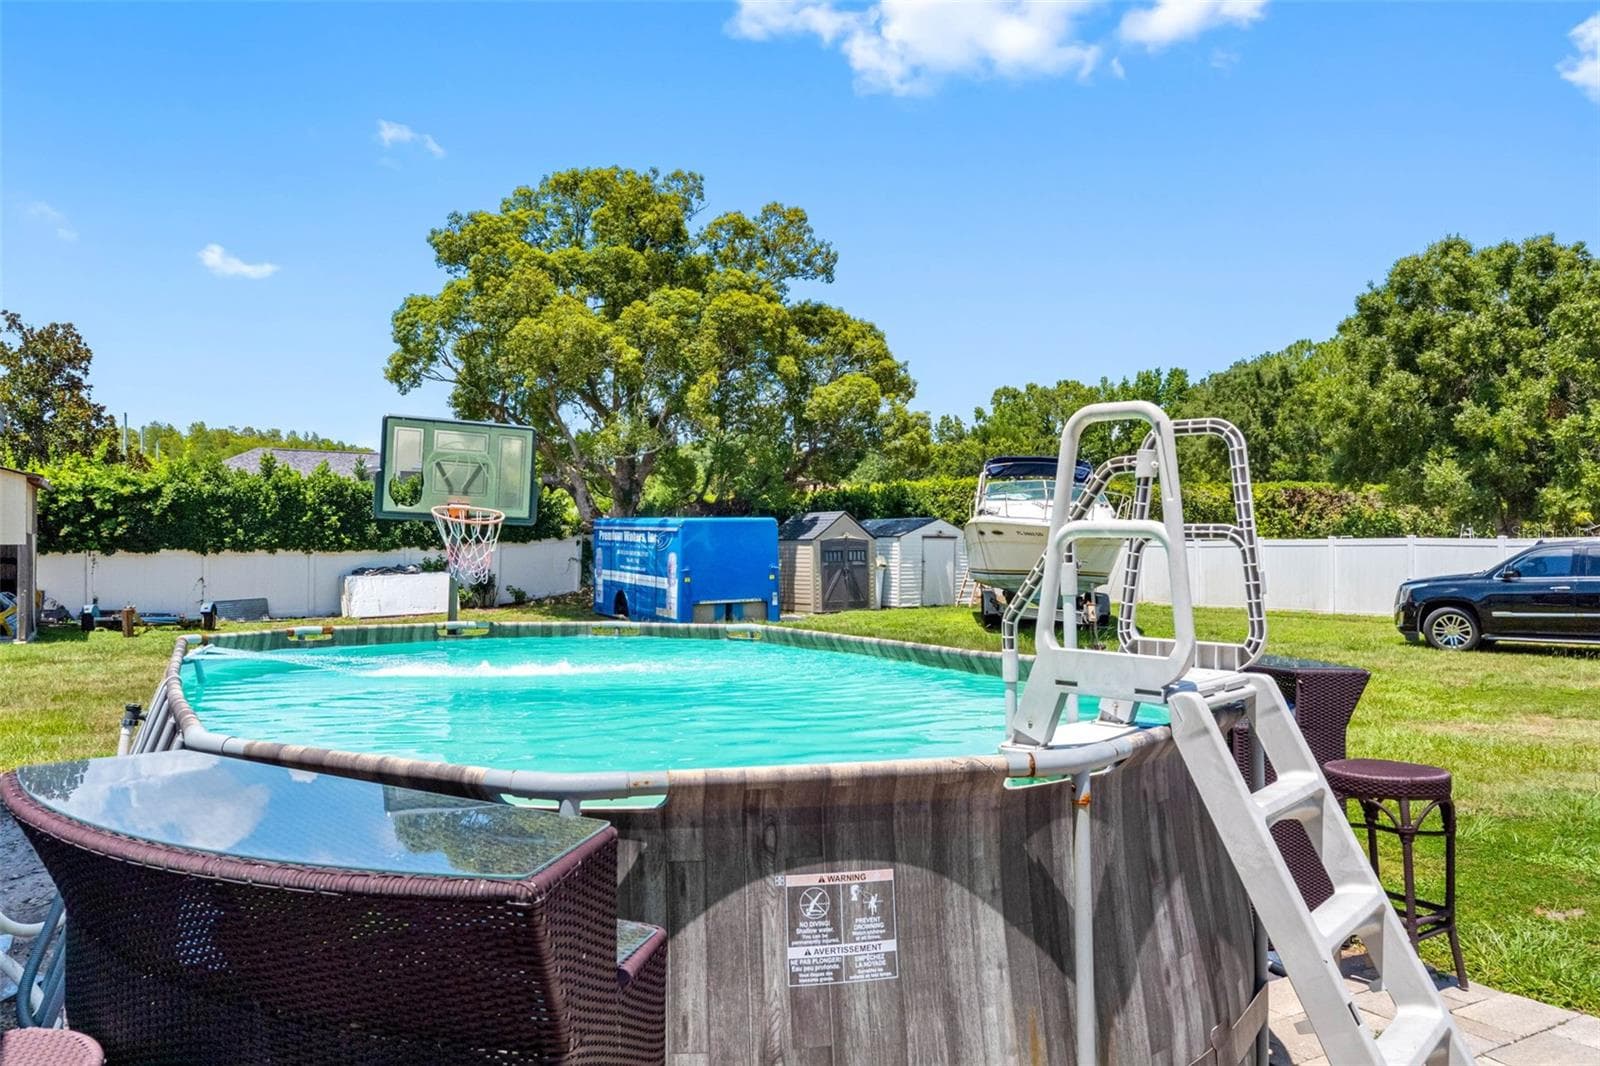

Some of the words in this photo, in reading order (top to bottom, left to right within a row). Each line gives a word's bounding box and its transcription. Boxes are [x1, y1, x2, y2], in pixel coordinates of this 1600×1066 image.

[598, 530, 623, 541] Premium
[624, 531, 647, 544] Waters,
[827, 873, 867, 883] WARNING
[810, 920, 830, 928] DIVING!
[855, 916, 881, 924] PREVENT
[853, 922, 885, 931] DROWNING
[813, 943, 882, 955] AVERTISSEMENT
[855, 961, 863, 969] LA
